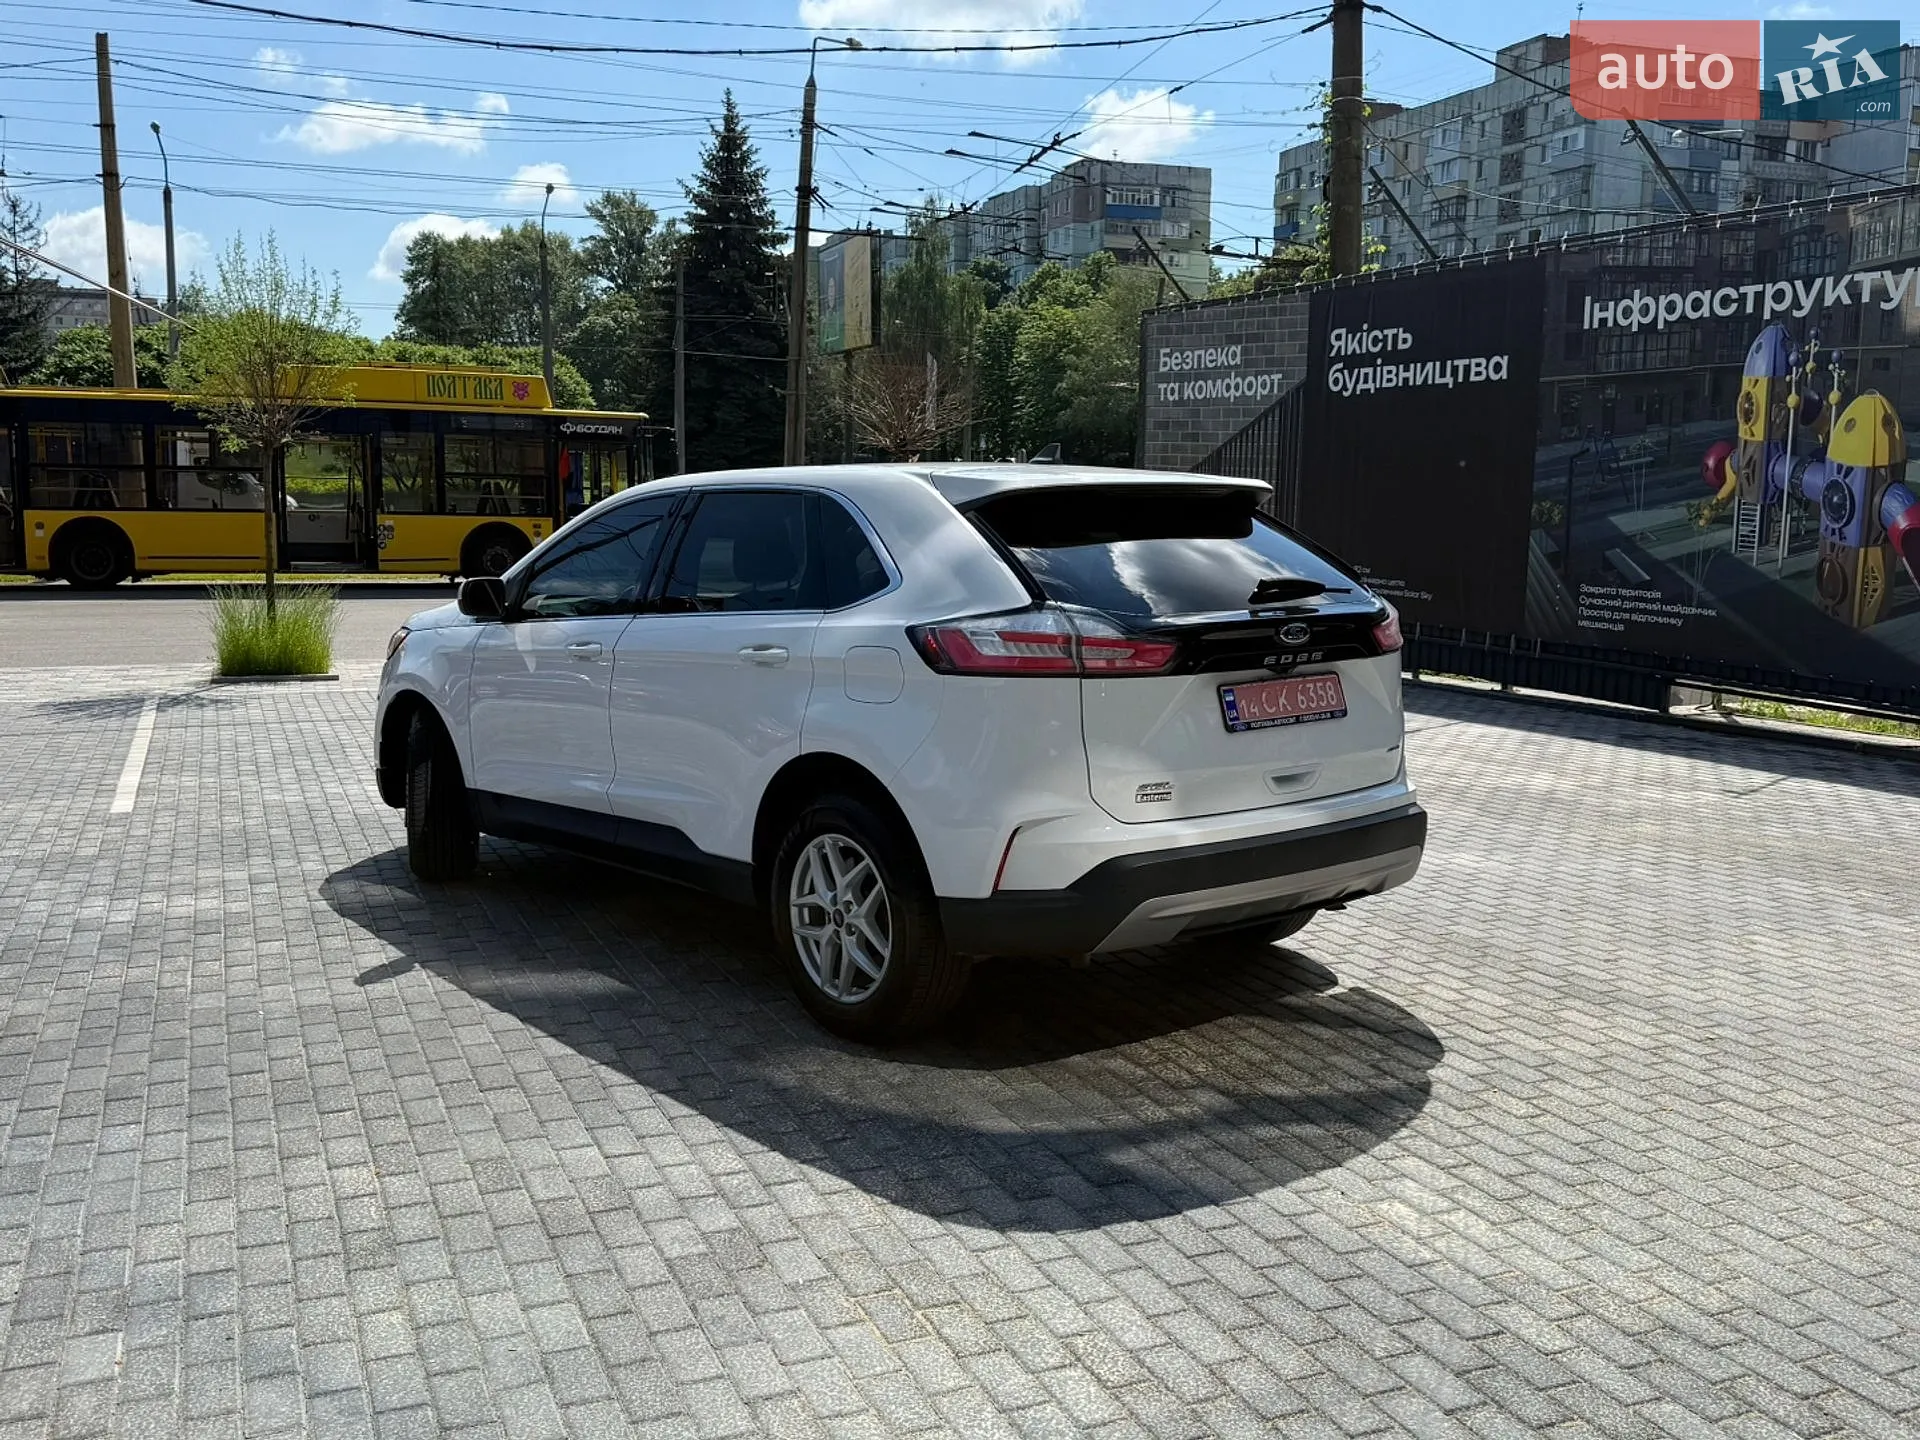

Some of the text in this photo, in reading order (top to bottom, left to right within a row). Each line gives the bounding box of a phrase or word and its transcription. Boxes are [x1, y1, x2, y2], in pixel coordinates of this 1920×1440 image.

[1583, 266, 1920, 332] Інфраструкту
[1328, 322, 1414, 357] Якість
[1159, 344, 1242, 372] Безпека
[426, 374, 504, 400] ПОЛТАВА
[1158, 371, 1283, 403] та комфорт
[1327, 355, 1510, 398] будівництва
[1579, 583, 1662, 599] Закрита територія
[1578, 594, 1718, 617] Сучасний дитячий майданчик
[1578, 606, 1612, 619] Простір
[1612, 611, 1630, 620] для
[1263, 651, 1324, 665] EDGE
[1239, 698, 1260, 718] 14
[1297, 682, 1338, 709] 6358
